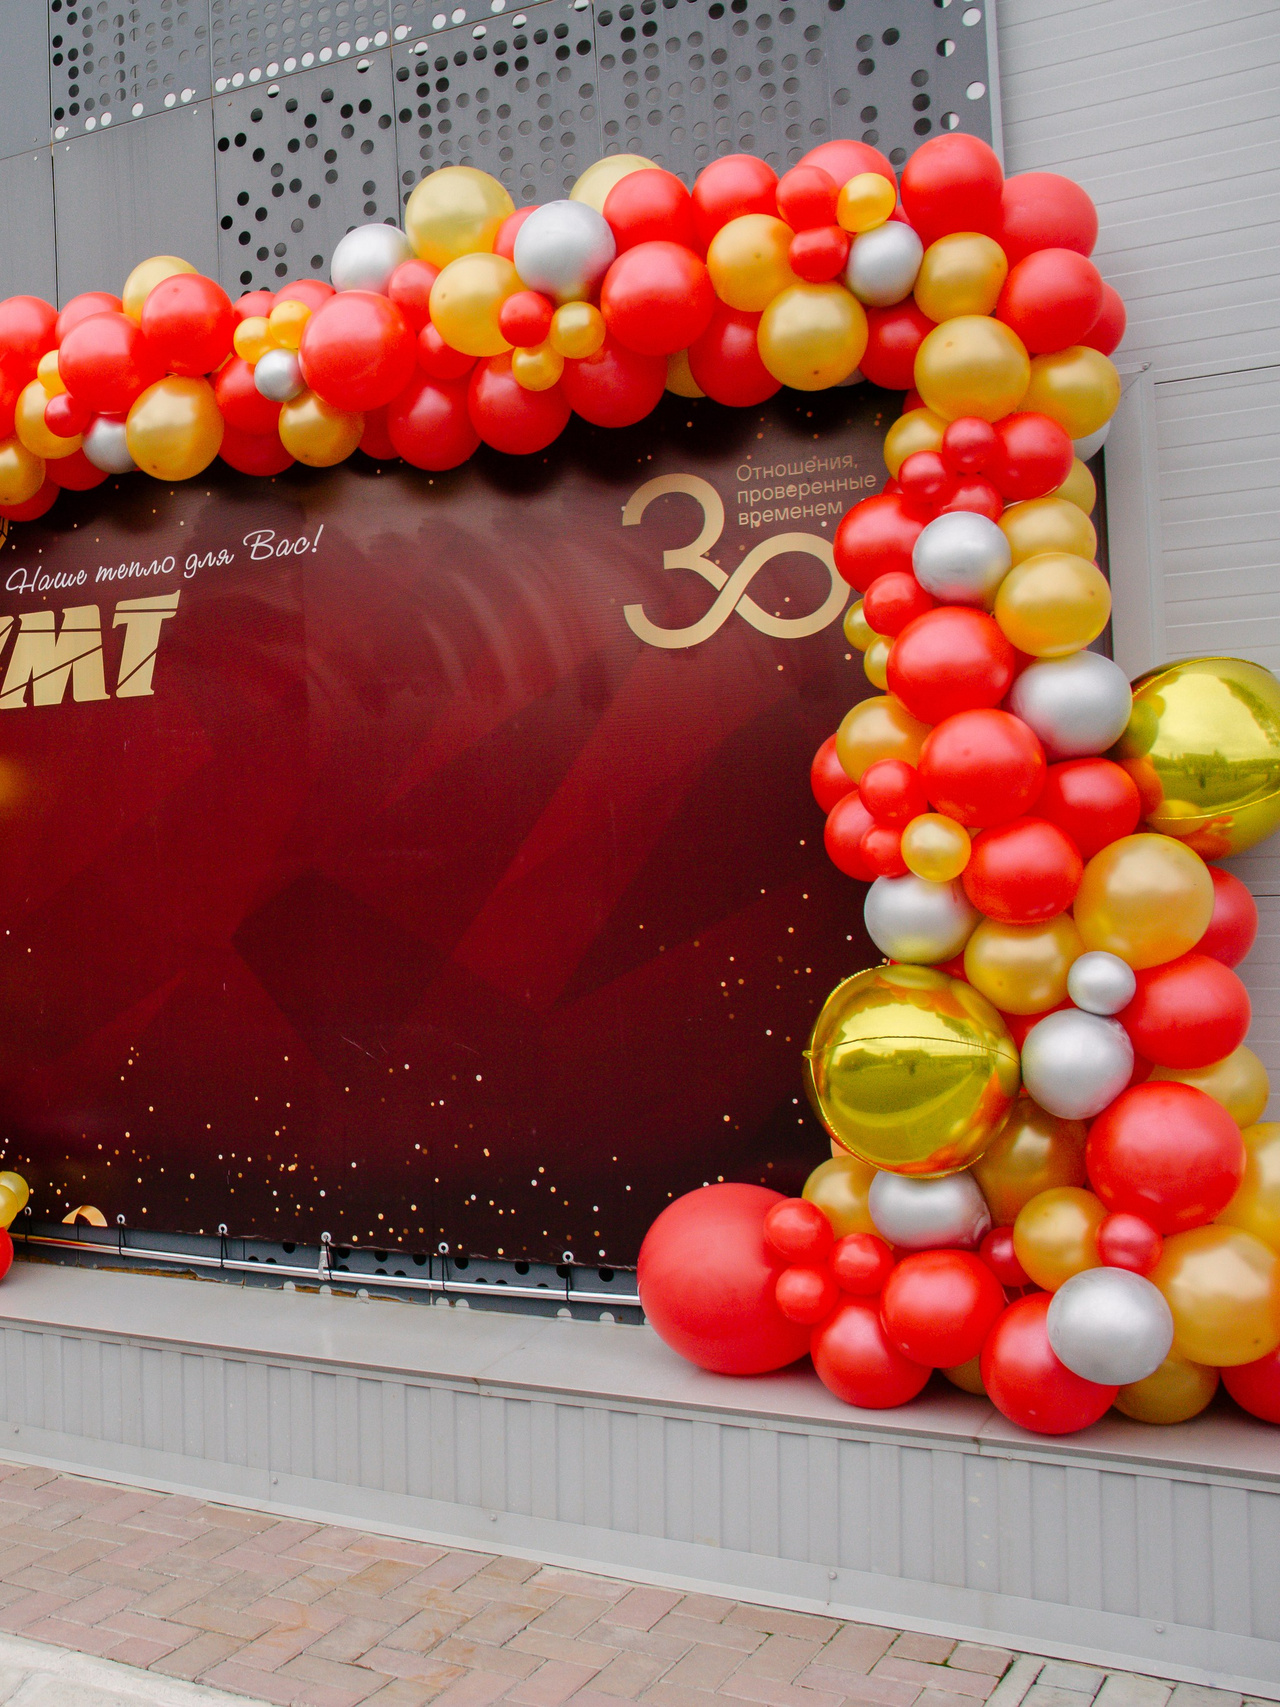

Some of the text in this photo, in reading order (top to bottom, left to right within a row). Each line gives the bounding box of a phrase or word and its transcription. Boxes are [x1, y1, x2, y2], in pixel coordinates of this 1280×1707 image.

[736, 454, 859, 482] Отношения,
[737, 473, 877, 505] проверенные
[738, 501, 843, 529] временем
[5, 523, 325, 595] Наше тепло для Вас!
